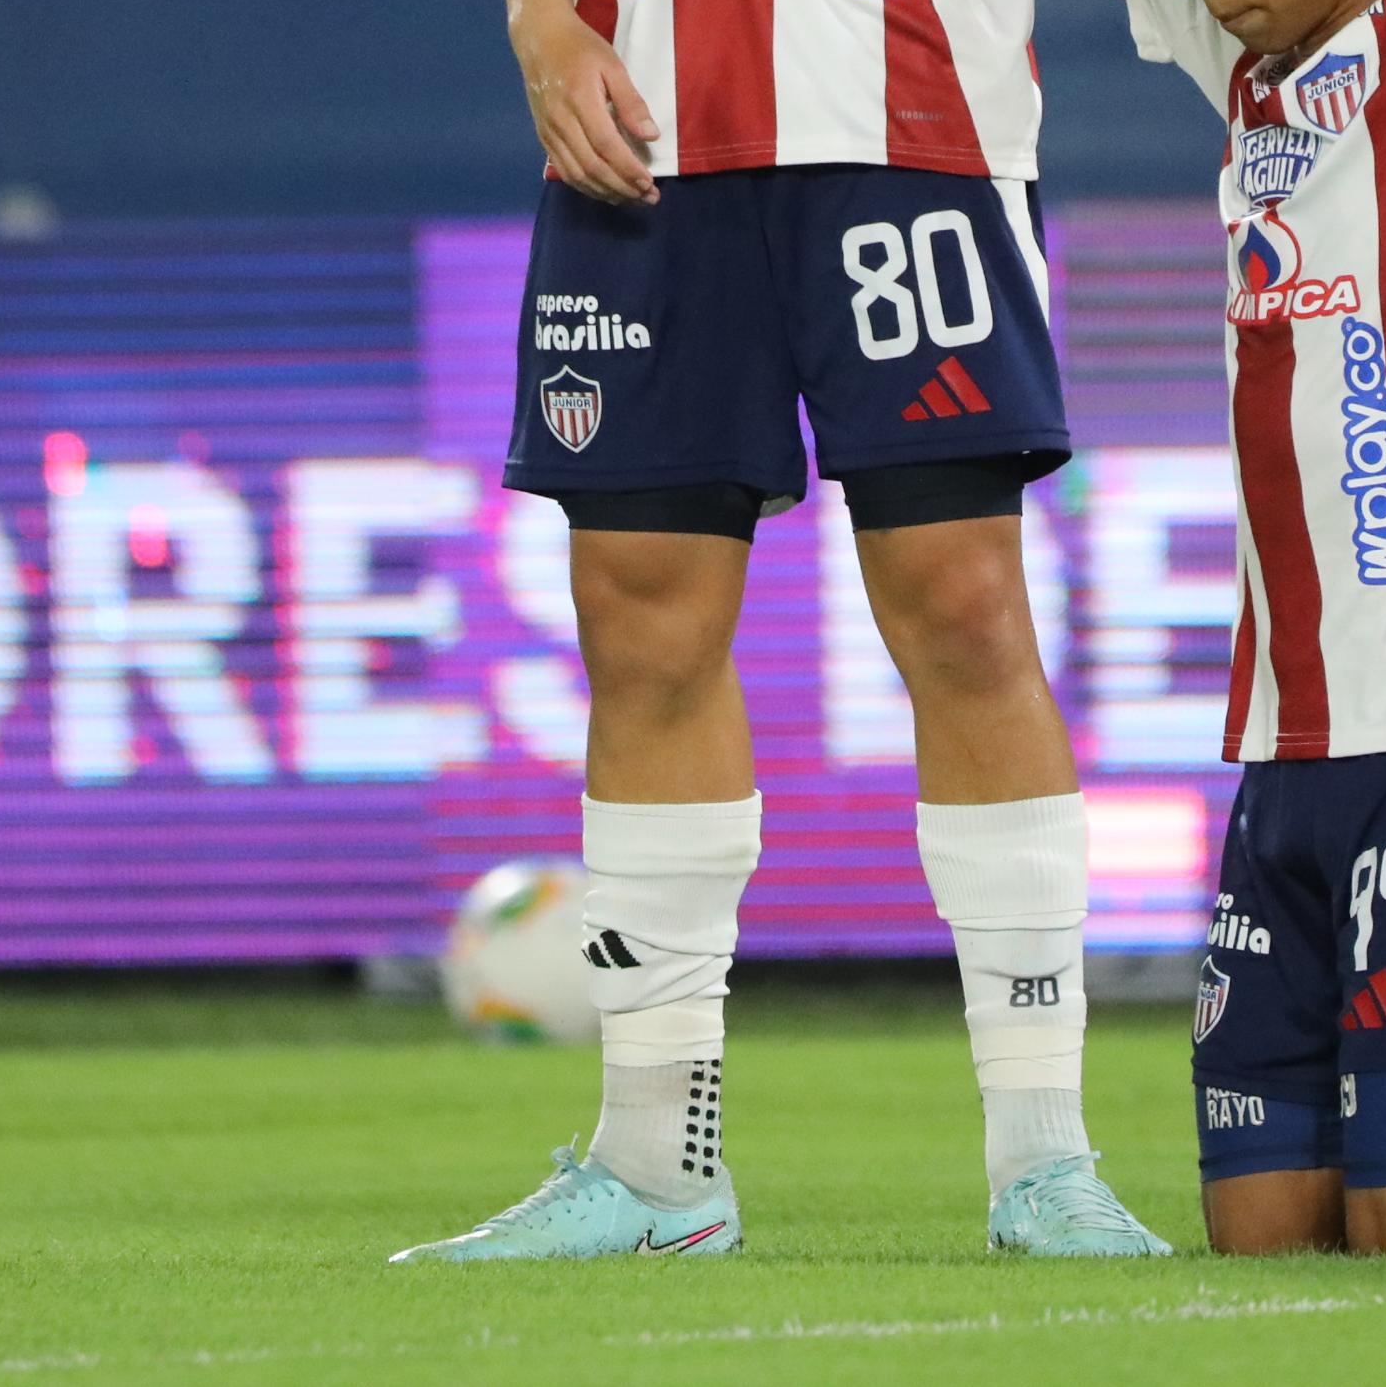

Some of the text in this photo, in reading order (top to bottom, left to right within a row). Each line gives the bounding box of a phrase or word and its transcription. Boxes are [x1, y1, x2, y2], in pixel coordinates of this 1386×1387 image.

[1307, 74, 1355, 100] JUNIOR
[841, 208, 994, 361] 80
[535, 314, 651, 351] brasilia
[551, 398, 592, 409] JUNIOR
[1009, 976, 1061, 1008] 80
[1206, 1095, 1265, 1130] RAYO
